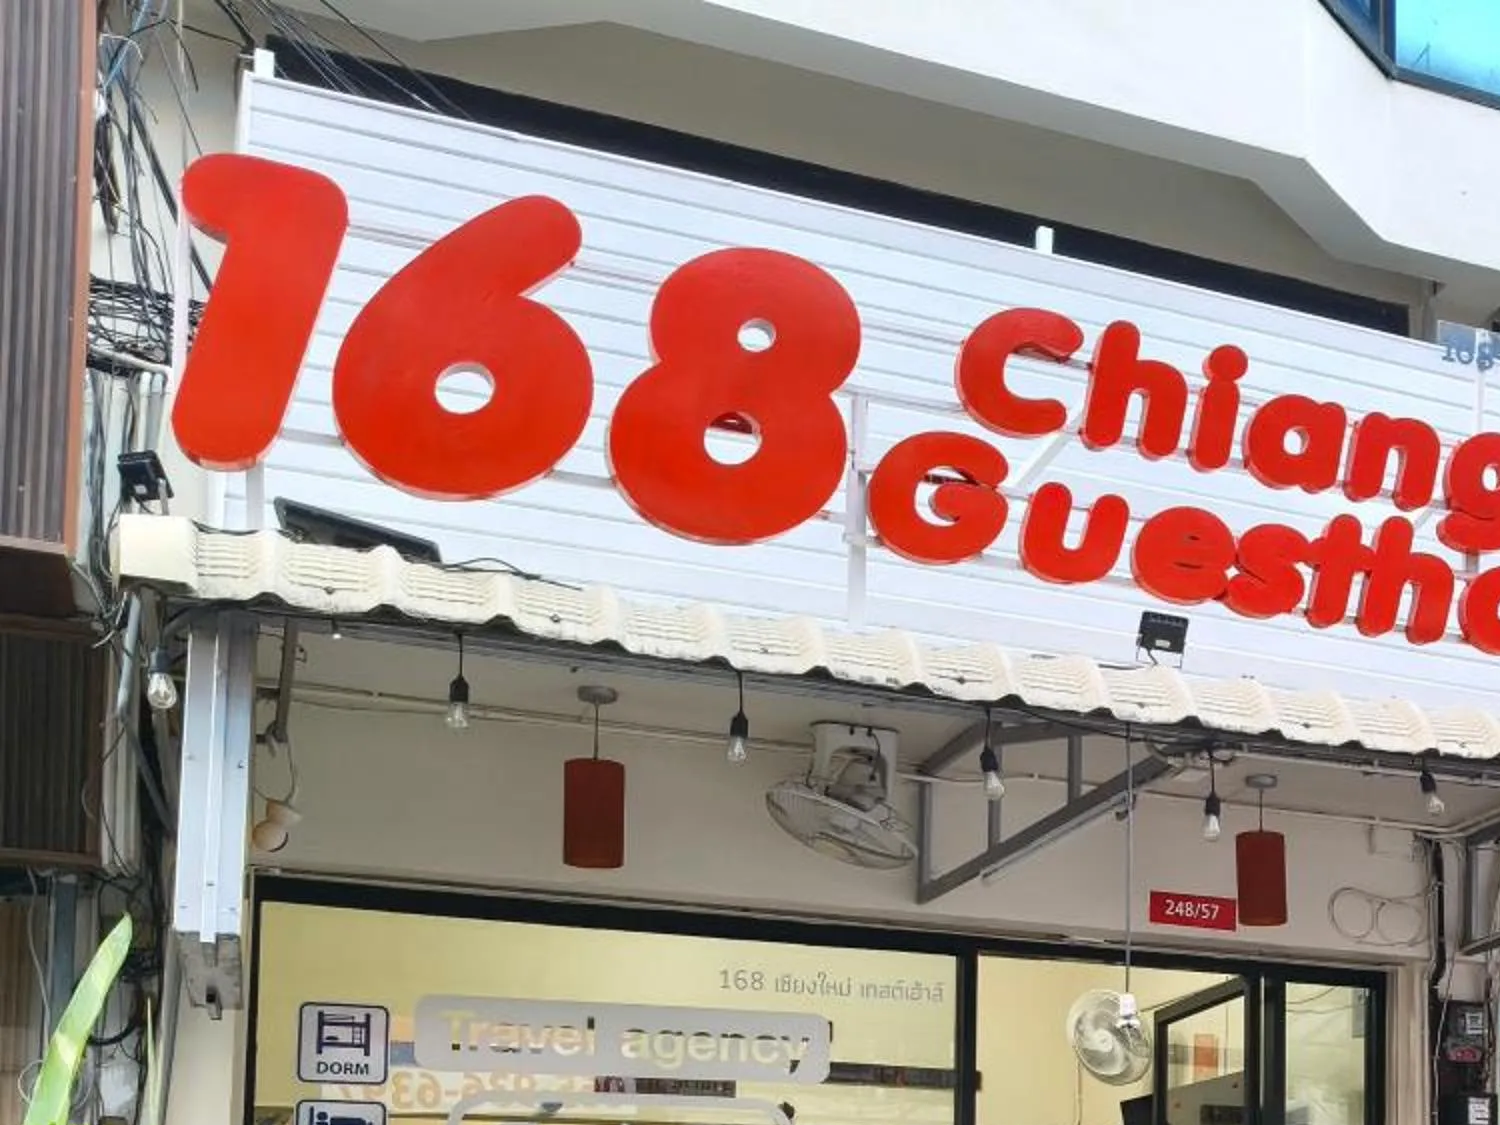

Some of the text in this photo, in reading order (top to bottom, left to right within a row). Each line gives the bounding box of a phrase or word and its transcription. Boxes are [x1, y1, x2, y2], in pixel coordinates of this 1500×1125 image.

[172, 153, 861, 545] 168
[1165, 899, 1219, 920] 248/57
[719, 968, 766, 991] 168
[439, 1009, 811, 1075] Travel agency
[316, 1060, 370, 1076] DORM
